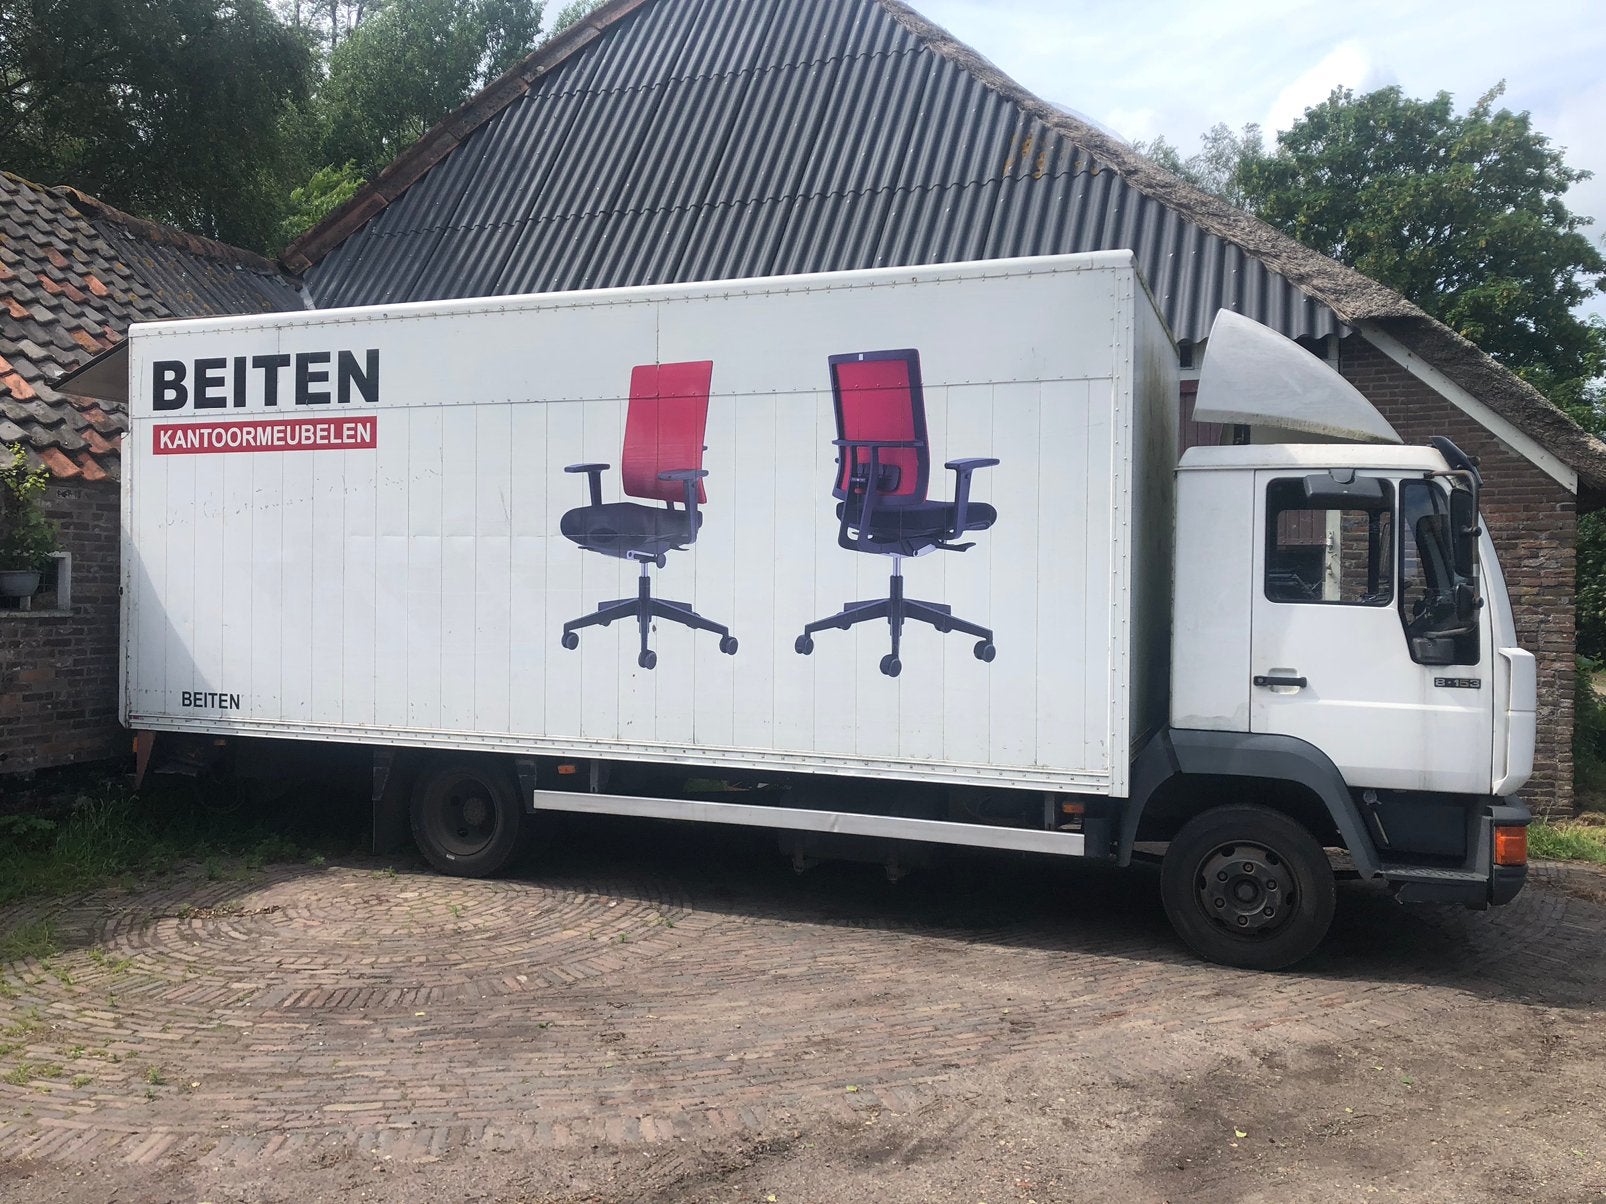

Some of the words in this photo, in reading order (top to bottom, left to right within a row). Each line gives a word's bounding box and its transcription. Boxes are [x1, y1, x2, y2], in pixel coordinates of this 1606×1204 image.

[153, 349, 379, 411] BEITEN
[160, 423, 371, 449] KANTOORMEUBELEN
[182, 691, 240, 709] BEITEN
